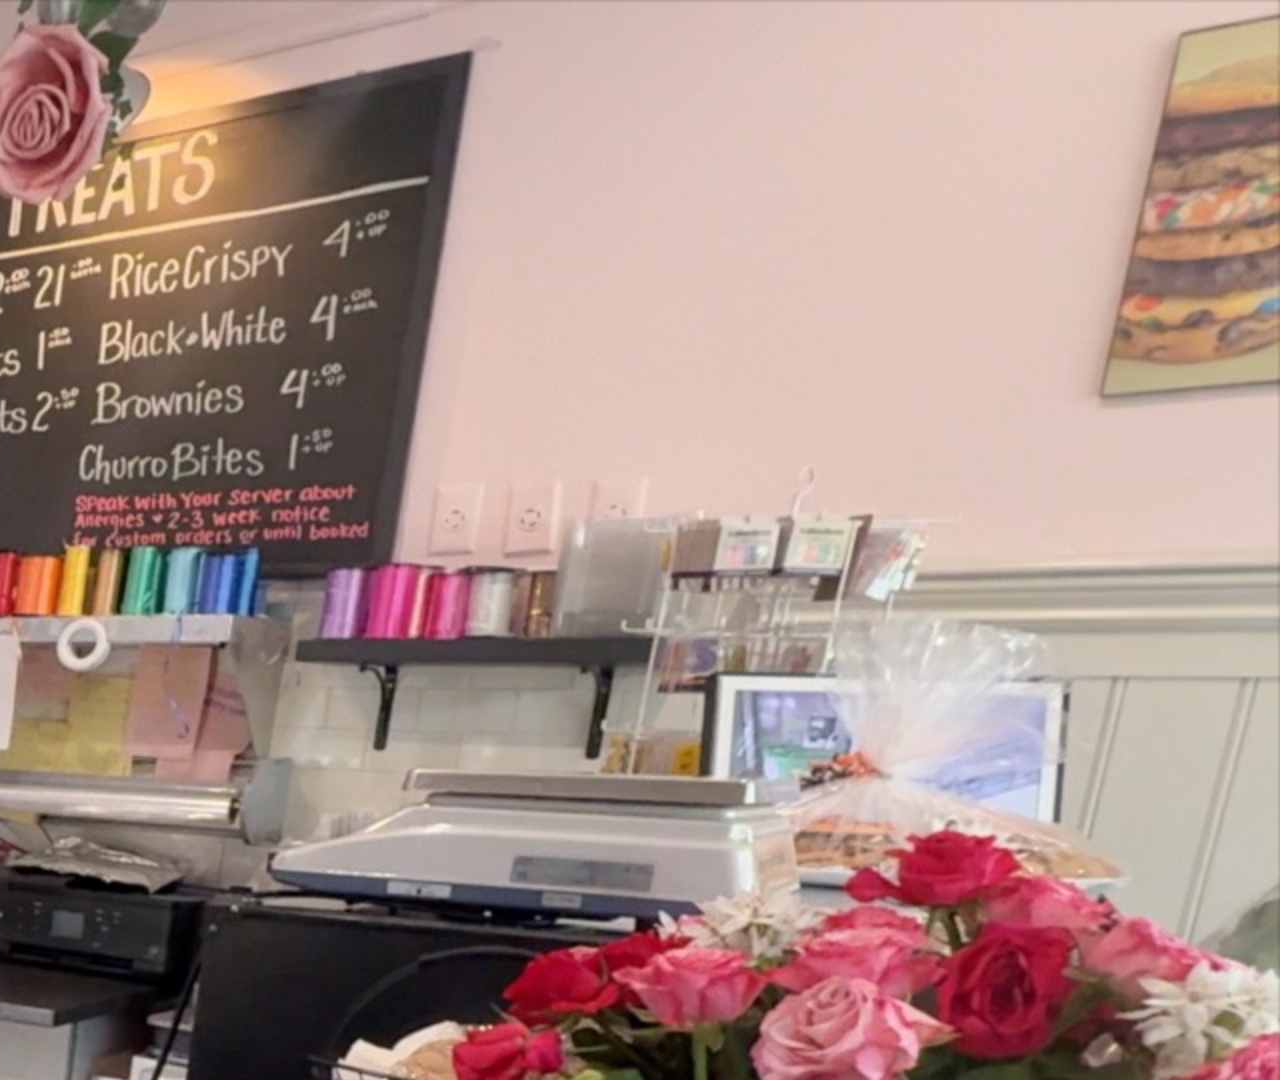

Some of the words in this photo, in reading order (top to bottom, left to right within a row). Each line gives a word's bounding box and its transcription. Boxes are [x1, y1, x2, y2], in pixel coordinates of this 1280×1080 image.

[98, 319, 187, 366] Black
[201, 305, 286, 351] White
[91, 380, 244, 425] Brownies
[78, 444, 168, 484] Churro
[171, 437, 264, 482] Bites
[134, 492, 178, 510] with
[299, 484, 357, 501] about
[105, 530, 167, 547] custom
[175, 527, 232, 544] orders
[240, 529, 257, 544] or
[263, 524, 302, 540] until
[310, 521, 368, 538] booked
[167, 510, 205, 529] 2-3
[212, 508, 261, 526] week
[272, 505, 331, 523] notice
